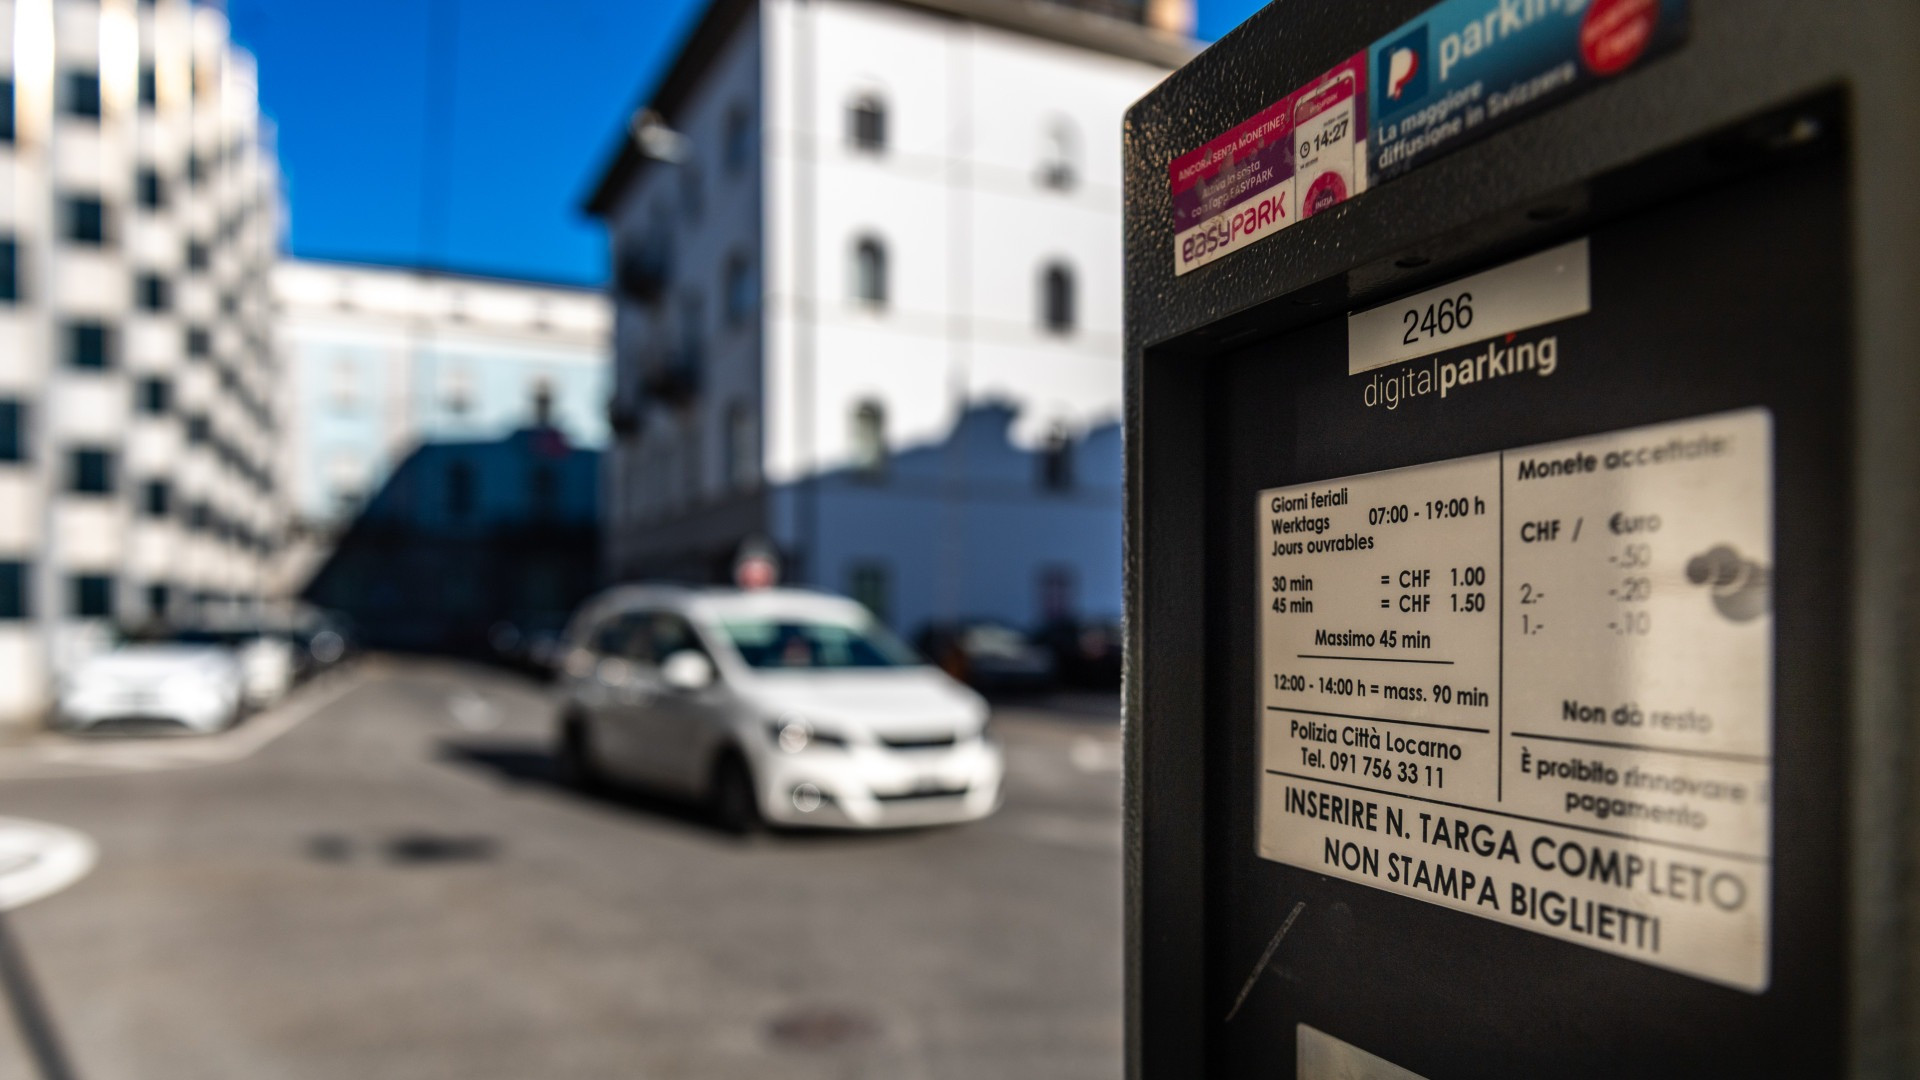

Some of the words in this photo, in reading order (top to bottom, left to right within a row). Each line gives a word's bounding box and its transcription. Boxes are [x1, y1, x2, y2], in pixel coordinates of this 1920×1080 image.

[1378, 122, 1397, 146] La
[1401, 80, 1484, 135] maggiore
[1178, 156, 1212, 182] ANCORA
[1238, 112, 1286, 148] MONETINE?
[1314, 118, 1349, 152] 14:27
[1378, 116, 1463, 168] diffusione
[1465, 104, 1485, 129] in
[1229, 167, 1274, 200] EASYPARK
[1236, 159, 1261, 183] sosta
[1403, 292, 1474, 345] 2466
[1364, 333, 1558, 411] digitalparking
[1517, 451, 1598, 482] Monete
[1271, 493, 1308, 513] Giorni
[1311, 488, 1348, 508] feriali
[1369, 504, 1409, 525] 07:00
[1426, 497, 1469, 520] 19:00
[1474, 496, 1485, 515] h
[1272, 516, 1330, 535] Werktags
[1520, 519, 1561, 543] CHF
[1272, 540, 1303, 557] Jours
[1307, 533, 1374, 554] ouvrables
[1272, 576, 1286, 592] 30
[1290, 575, 1313, 591] min
[1399, 569, 1430, 588] CHF
[1450, 566, 1486, 587] 1.00
[1520, 583, 1544, 604] 2.-
[1272, 597, 1286, 613] 45
[1290, 597, 1313, 613] min
[1399, 594, 1430, 612] CHF
[1450, 593, 1486, 612] 1.50
[1315, 629, 1375, 647] Massimo
[1379, 630, 1397, 648] 45
[1402, 631, 1431, 649] min
[1522, 614, 1544, 635] 1.-
[1273, 674, 1305, 692] 12:00
[1319, 677, 1352, 696] 14:00
[1357, 679, 1366, 697] h
[1384, 685, 1427, 702] mass.
[1433, 684, 1452, 704] 90
[1457, 687, 1489, 707] min
[1562, 700, 1606, 724] Non
[1611, 702, 1644, 727] dà
[1651, 708, 1713, 734] resto
[1291, 719, 1337, 744] Polizia
[1342, 726, 1380, 750] Città
[1386, 731, 1462, 761] Locarno
[1301, 747, 1326, 769] Tel.
[1329, 751, 1356, 774] 091
[1362, 756, 1392, 779] 756
[1397, 761, 1419, 784] 33
[1425, 765, 1443, 788] 11
[1521, 746, 1531, 773] È
[1537, 758, 1619, 786] proibito
[1624, 766, 1747, 803] rinnovare
[1565, 792, 1708, 830] pagamento
[1285, 786, 1378, 832] INSERIRE
[1386, 806, 1411, 840] N.
[1419, 812, 1521, 864] TARGA
[1531, 836, 1747, 912] COMPLETO
[1324, 836, 1379, 878] NON
[1387, 852, 1500, 911] STAMPA
[1511, 882, 1660, 953] BIGLIETTI
